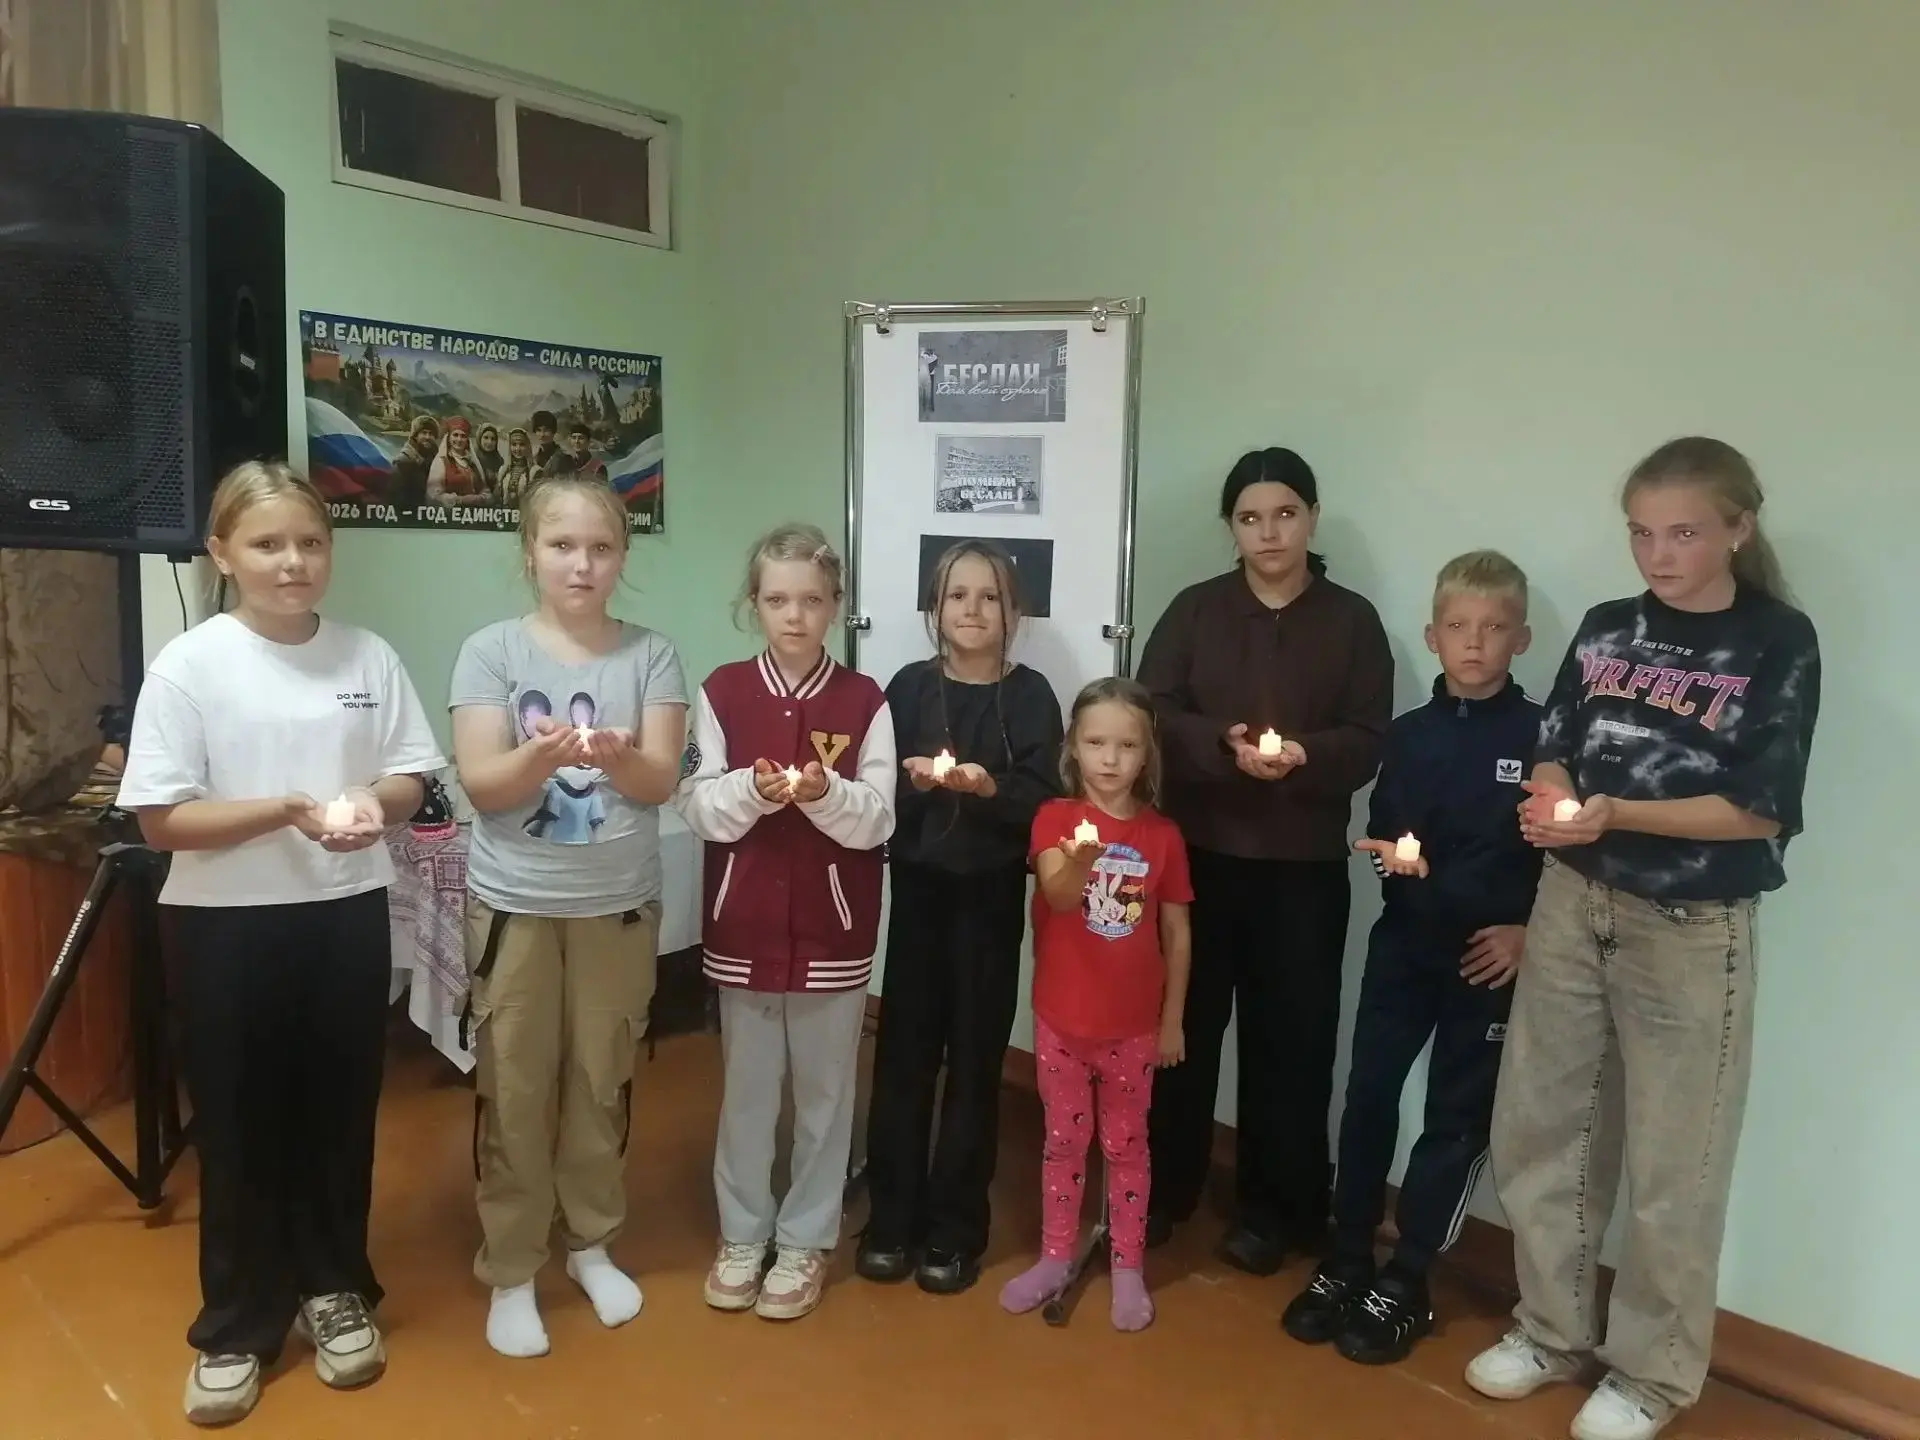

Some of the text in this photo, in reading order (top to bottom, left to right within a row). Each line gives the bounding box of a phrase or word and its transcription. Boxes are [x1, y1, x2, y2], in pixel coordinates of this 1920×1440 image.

[314, 320, 327, 338] В
[334, 322, 434, 350] ЕДИНСТВЕ
[440, 335, 519, 361] НАРОДОВ
[540, 349, 583, 369] СИЛА
[588, 355, 650, 376] РОССИИ!
[366, 504, 398, 523] ГОД
[417, 506, 448, 524] ГОД
[452, 507, 521, 525] ЕДИНСТВ
[628, 512, 651, 526] СИИ
[810, 730, 851, 769] Y
